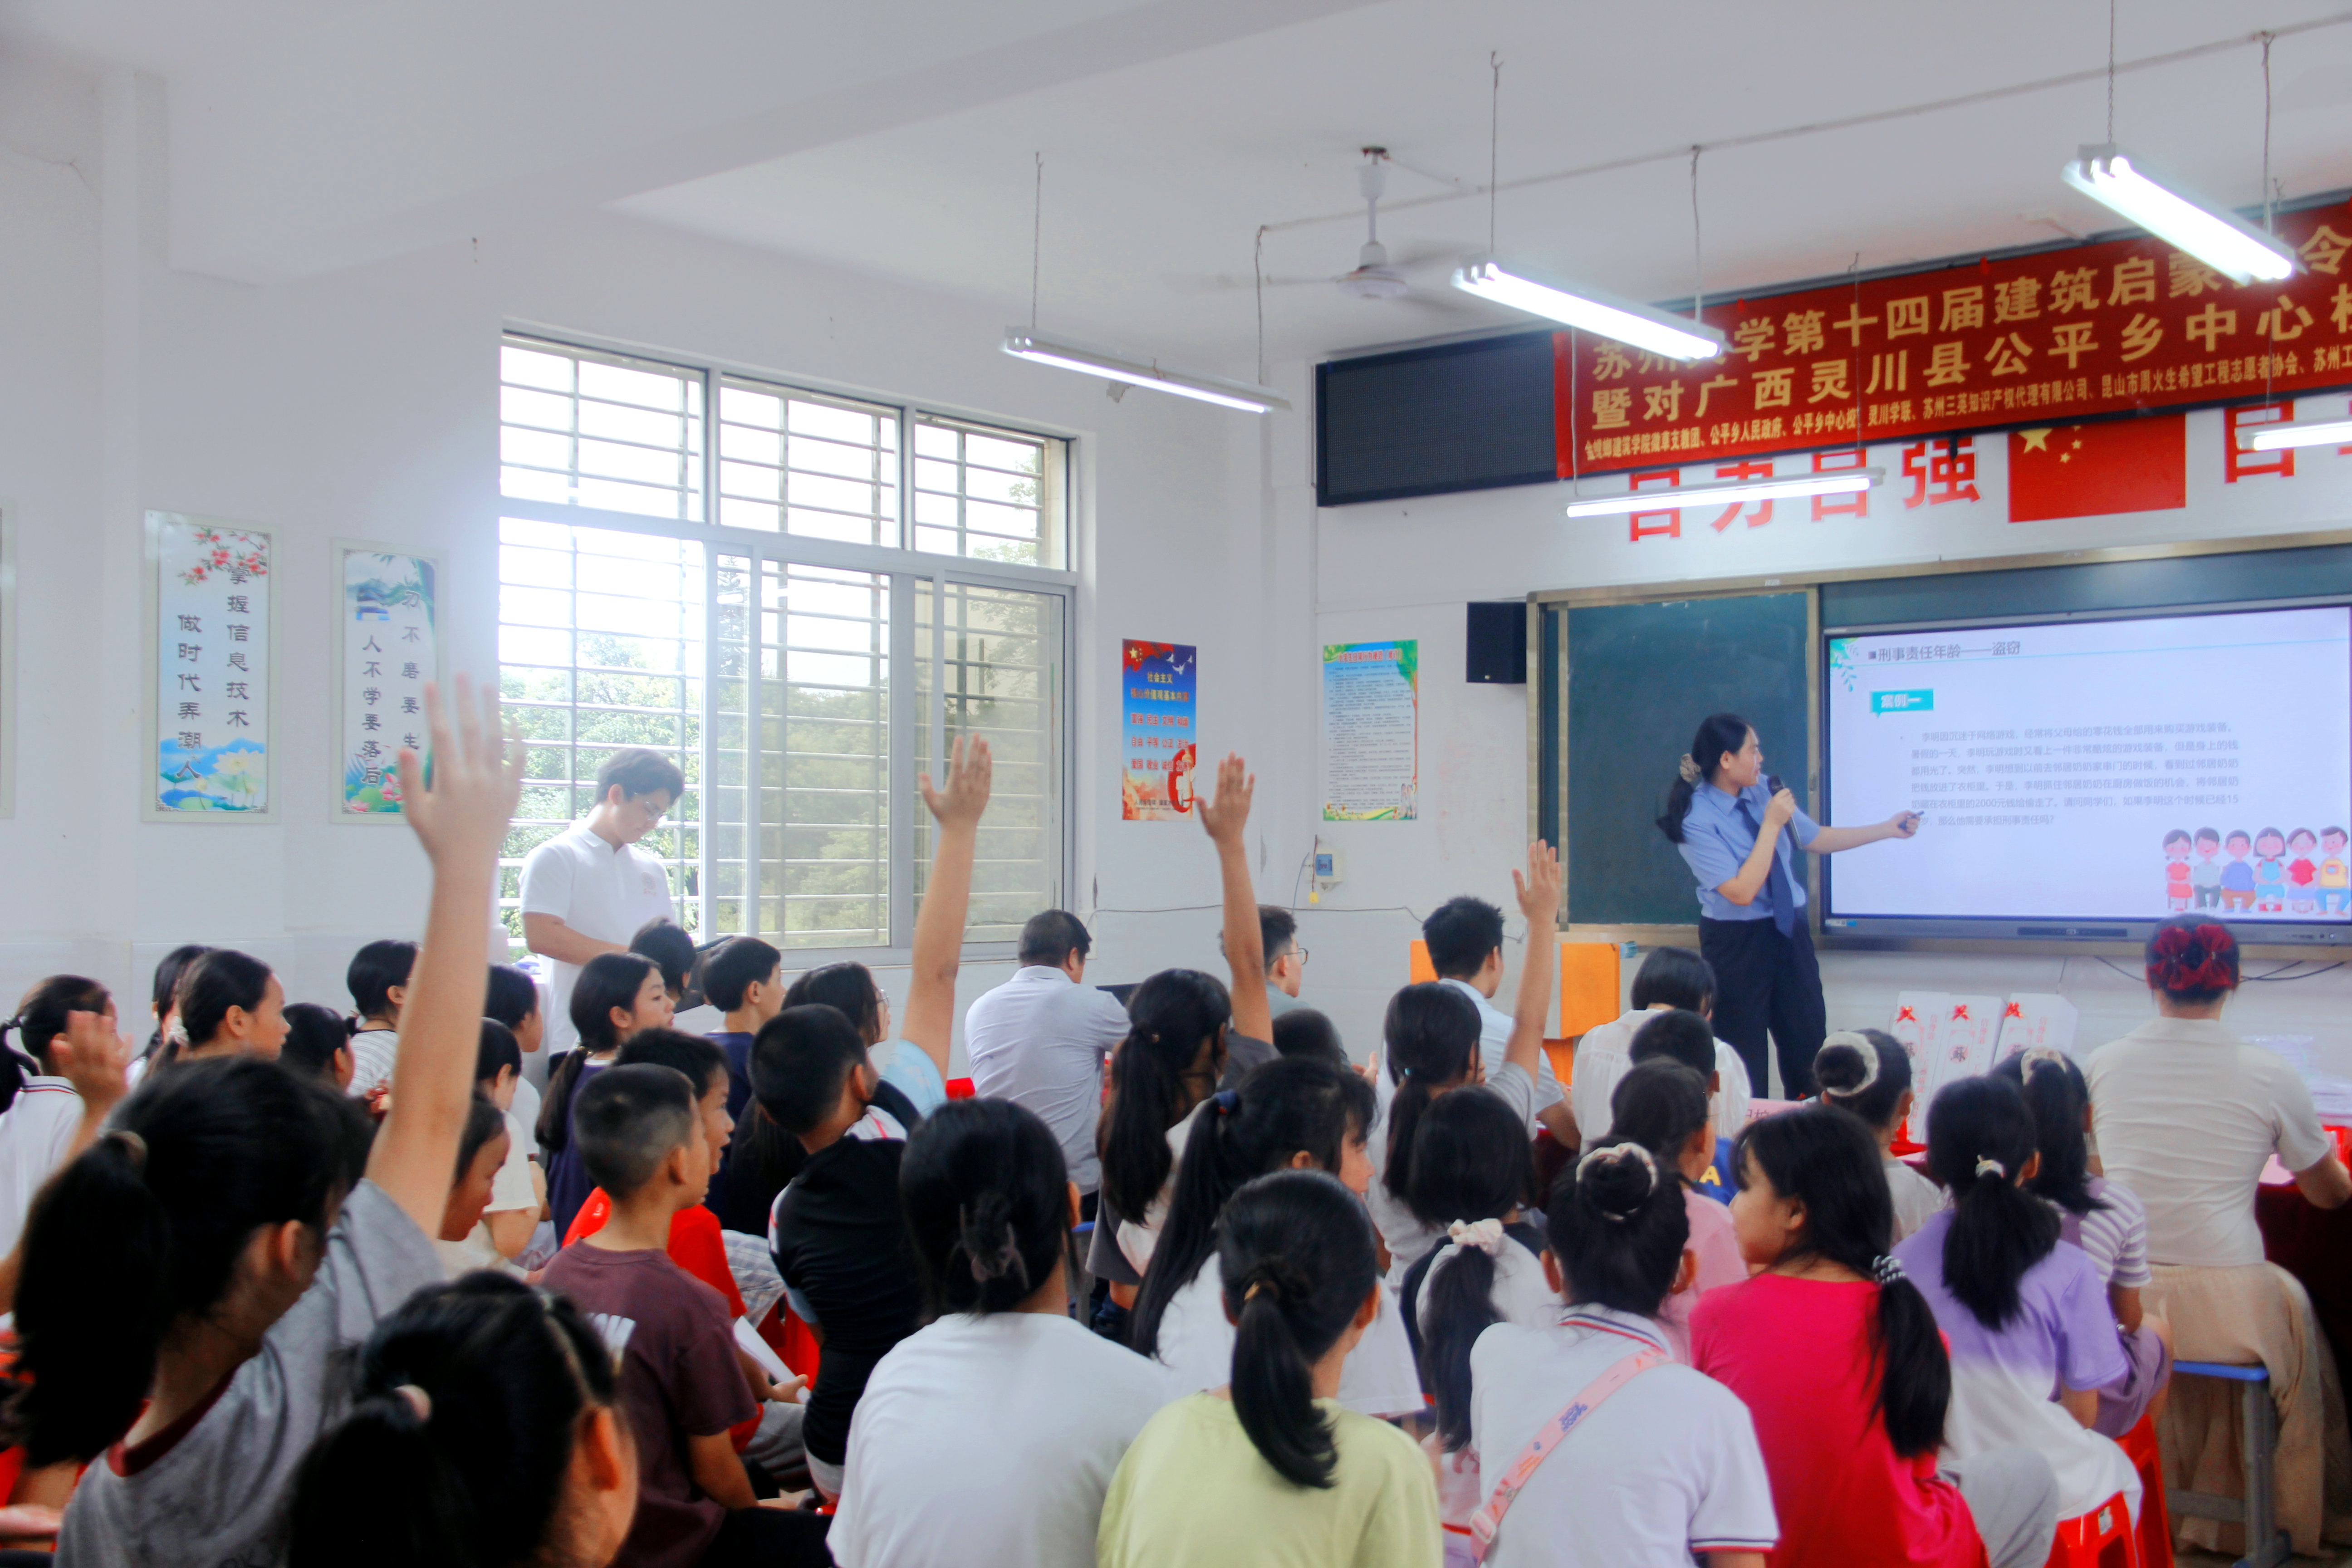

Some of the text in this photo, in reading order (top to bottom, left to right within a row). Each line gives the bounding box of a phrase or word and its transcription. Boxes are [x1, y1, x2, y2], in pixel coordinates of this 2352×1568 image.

[177, 614, 203, 779] 做时代弄潮人
[227, 565, 250, 728] 掌握信息技术
[362, 634, 382, 784] 人不学要落后
[1147, 671, 1173, 684] 社会主义
[1881, 693, 1922, 708] 案例一
